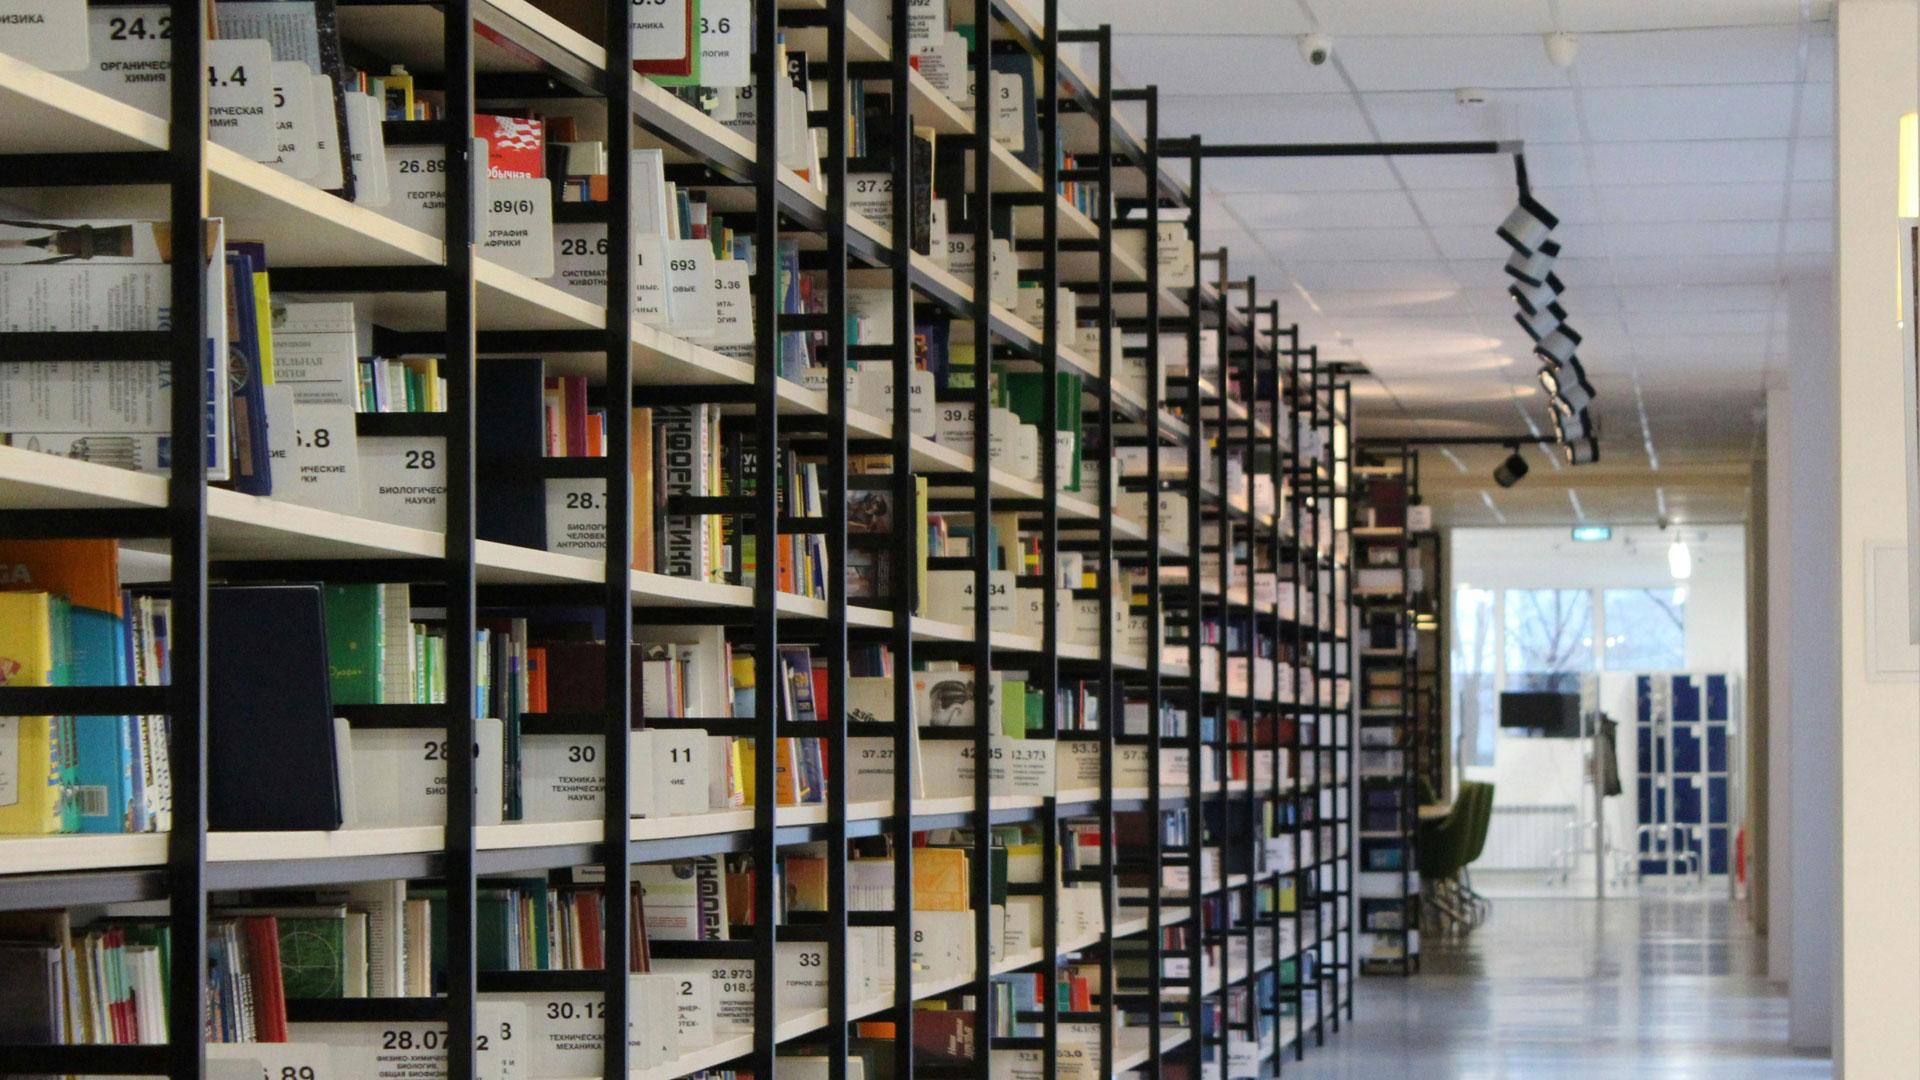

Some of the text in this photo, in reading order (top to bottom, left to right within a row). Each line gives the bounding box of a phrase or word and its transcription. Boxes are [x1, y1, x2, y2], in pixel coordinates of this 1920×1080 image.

[109, 17, 172, 41] 24.2
[124, 73, 167, 84] ХИМИЯ
[399, 160, 447, 174] 26.89
[561, 238, 608, 256] 28.6
[948, 239, 975, 253] 39.
[671, 259, 696, 271] 693
[405, 450, 436, 469] 28
[665, 404, 693, 578] ИНФОРМТИКА
[404, 496, 437, 505] НАУКИ
[568, 745, 596, 763] 30
[799, 952, 821, 967] 33
[382, 1030, 448, 1050] 28.07
[556, 1043, 603, 1051] МЕХАНИКА
